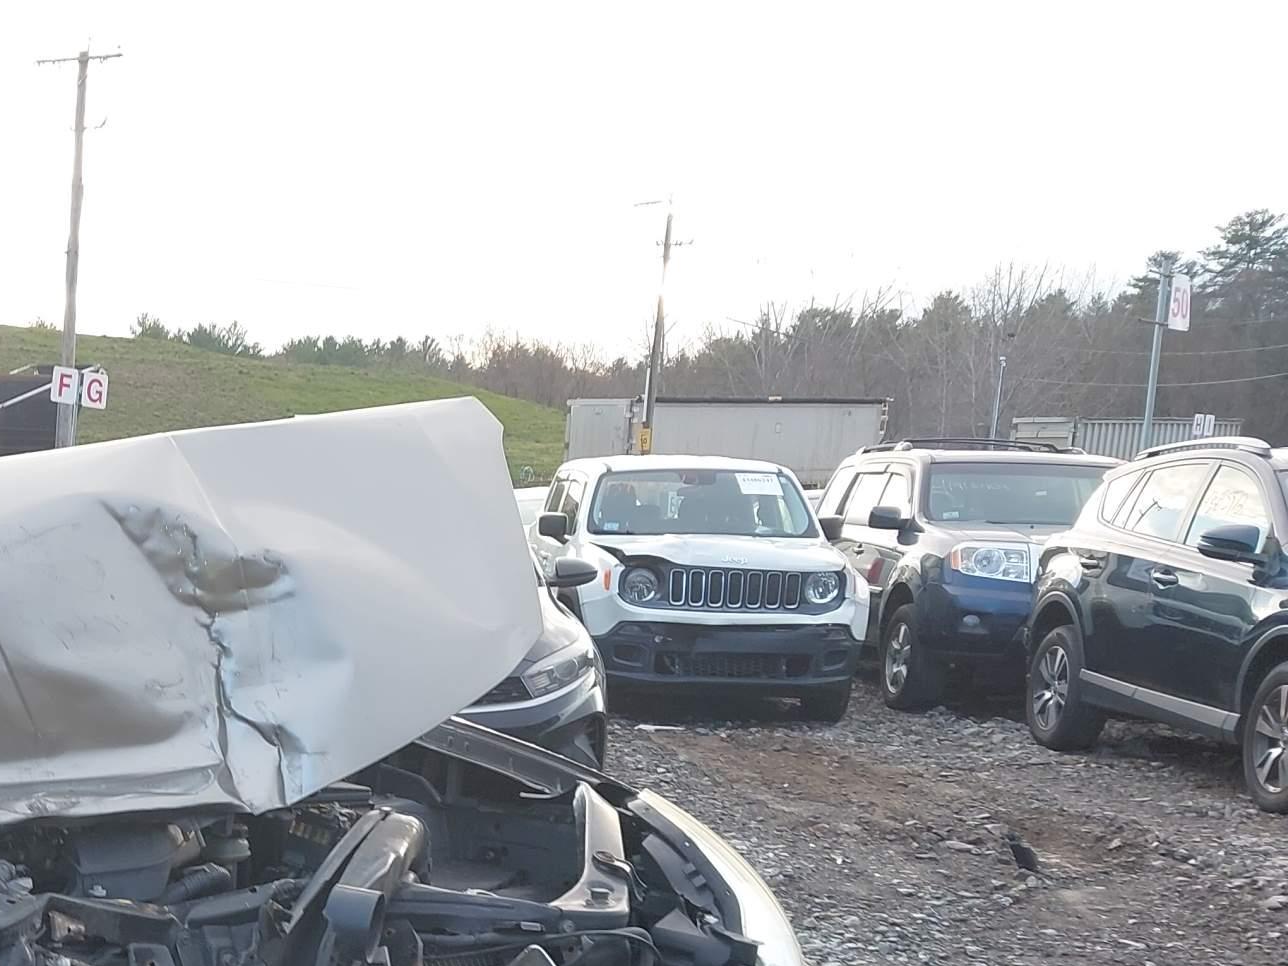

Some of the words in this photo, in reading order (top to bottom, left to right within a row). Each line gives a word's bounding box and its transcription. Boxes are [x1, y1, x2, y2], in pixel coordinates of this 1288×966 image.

[1171, 286, 1189, 319] 50
[57, 372, 73, 398] F
[86, 378, 104, 405] G
